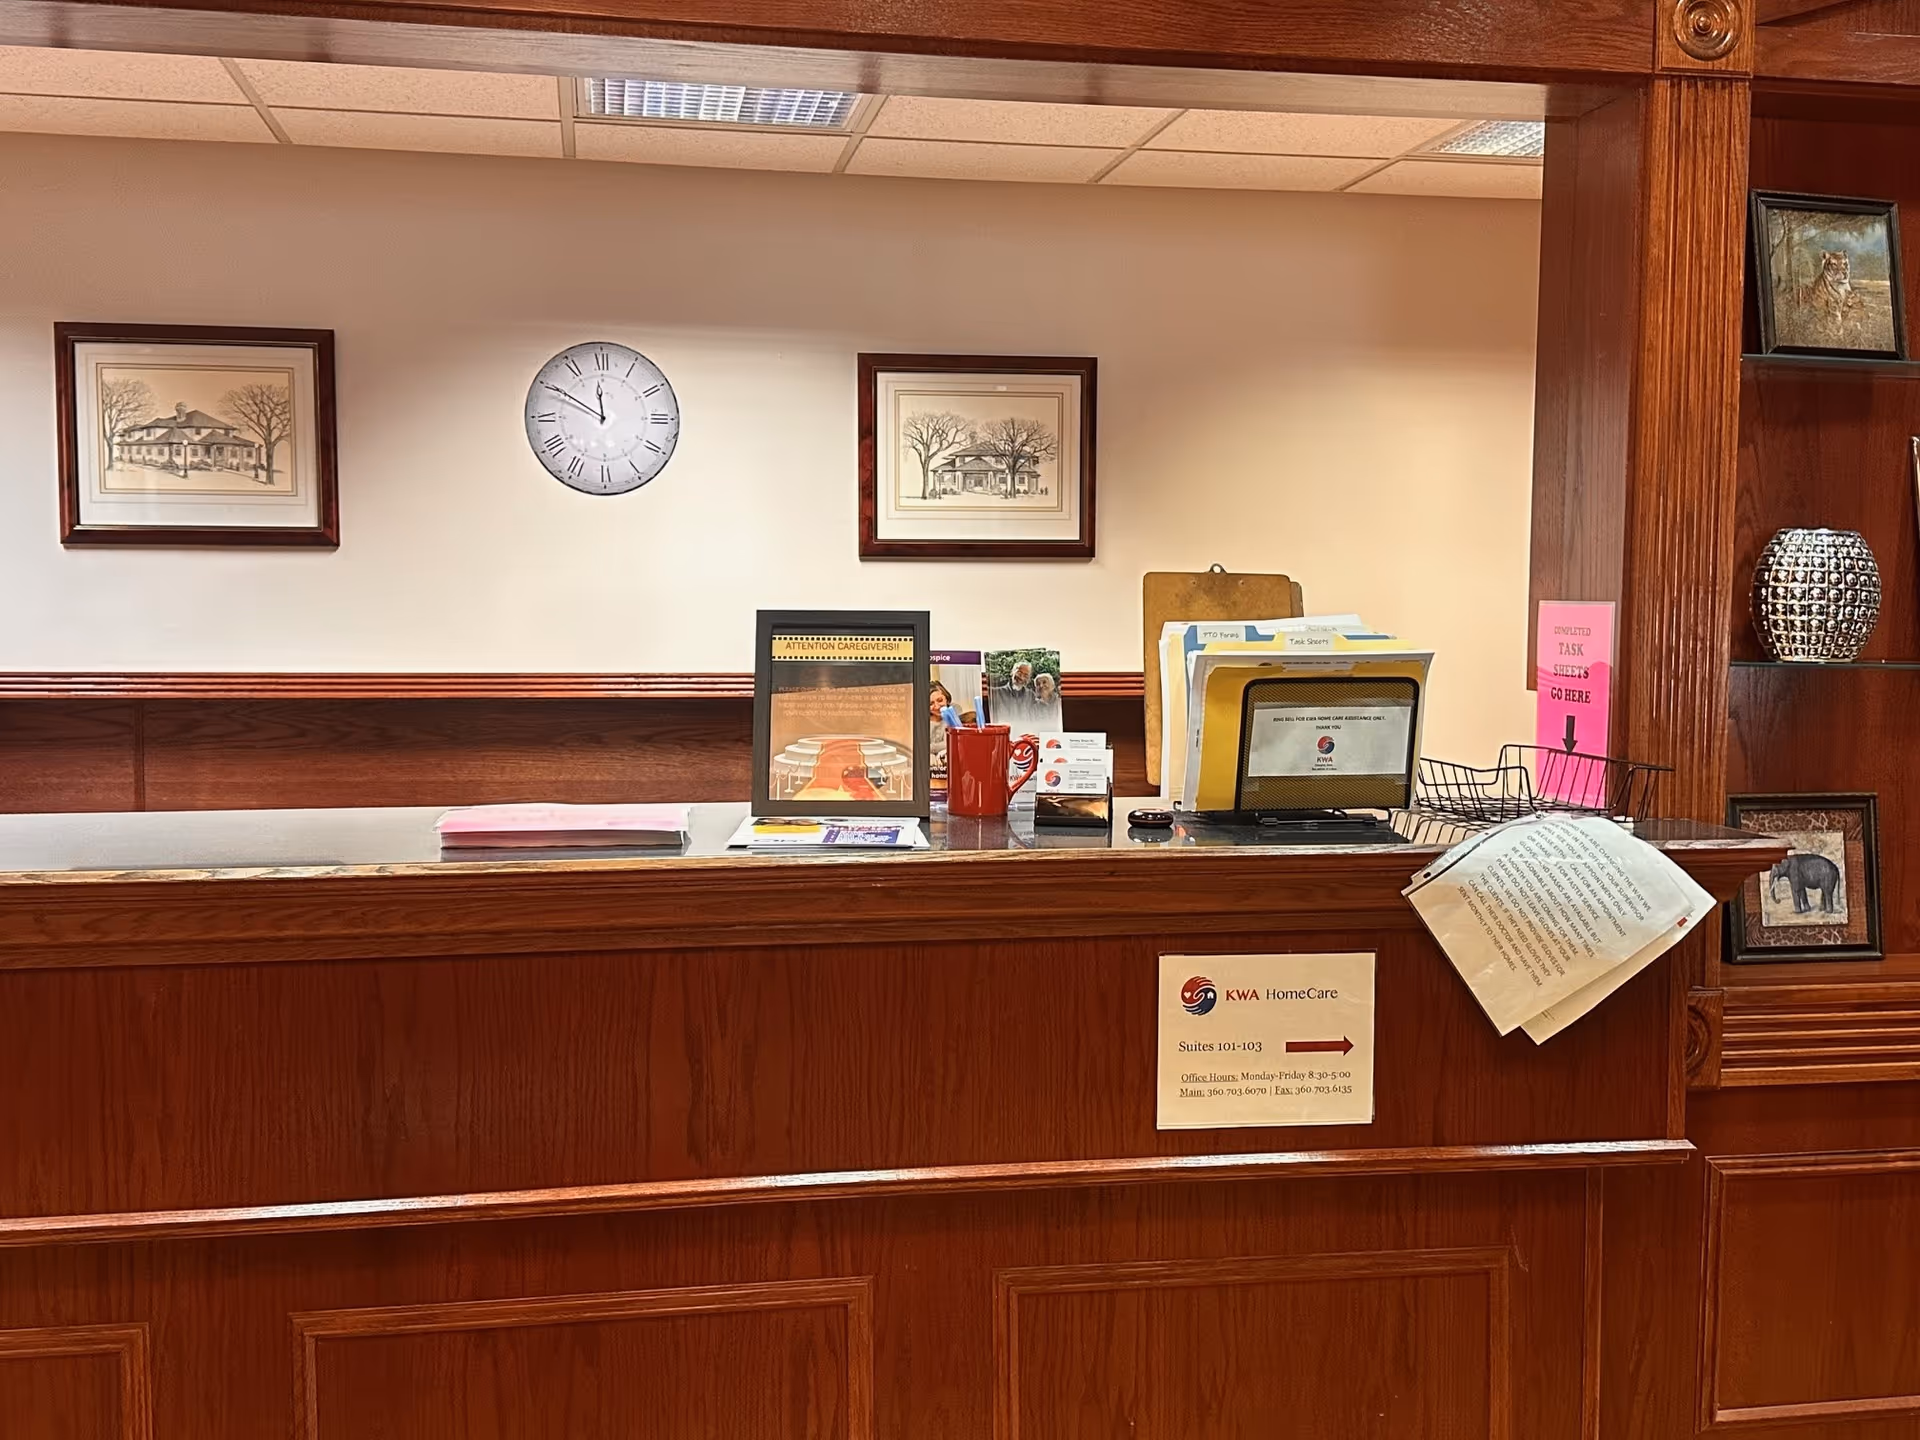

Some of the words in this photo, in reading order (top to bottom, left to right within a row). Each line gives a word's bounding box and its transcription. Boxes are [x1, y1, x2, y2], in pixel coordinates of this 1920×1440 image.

[785, 642, 835, 651] ATTENTION
[837, 642, 900, 651] CAREGIVERS!!
[1289, 638, 1306, 646] Task
[1307, 638, 1329, 646] Sheets
[1554, 626, 1591, 636] COMPLETED
[1559, 642, 1584, 656] TASK
[1553, 664, 1590, 679] SHEETS
[1551, 687, 1563, 700] GO
[1564, 689, 1591, 704] HERE
[1557, 865, 1568, 877] FOR
[1566, 877, 1583, 898] FASTER
[1578, 841, 1589, 852] THE
[1605, 872, 1620, 888] YOUR
[1617, 886, 1644, 921] SUPERVISOR
[1581, 862, 1615, 901] APPOINTMENT
[1588, 838, 1600, 849] ARE
[1598, 847, 1625, 877] CHANGING
[1623, 875, 1634, 888] THE
[1631, 886, 1644, 902] WAY
[1642, 900, 1652, 912] WE
[1496, 858, 1513, 878] PLEASE
[1510, 877, 1520, 888] DO
[1517, 887, 1529, 900] NOT
[1525, 899, 1540, 917] LEAVE
[1537, 916, 1555, 939] GLOVES
[1551, 937, 1560, 946] AT
[1557, 945, 1570, 961] YOUR
[1507, 857, 1526, 879] MONTH
[1524, 878, 1535, 892] YOU
[1532, 891, 1543, 903] ARE
[1540, 902, 1559, 927] COMING
[1557, 926, 1567, 938] FOR
[1548, 872, 1564, 892] MASKS
[1562, 891, 1573, 904] ARE
[1570, 903, 1592, 932] AVAILABLE
[1589, 931, 1601, 944] BUT
[1569, 863, 1581, 877] CALL
[1579, 876, 1591, 889] FOR
[1588, 887, 1598, 898] AN
[1595, 897, 1626, 937] APPOINTMENT
[1456, 885, 1470, 900] SENT
[1466, 899, 1487, 927] MONTHLY
[1484, 926, 1493, 936] TO
[1489, 934, 1503, 951] THEIR
[1467, 878, 1479, 892] CAN
[1475, 890, 1487, 905] CALL
[1484, 904, 1498, 921] THEIR
[1495, 919, 1513, 943] DOCTOR
[1510, 942, 1522, 956] AND
[1518, 954, 1532, 971] HAVE
[1528, 969, 1542, 987] THEM
[1479, 873, 1489, 886] THE
[1506, 913, 1519, 928] THEY
[1514, 927, 1528, 943] NEED
[1524, 941, 1542, 964] GLOVES
[1538, 962, 1551, 977] THEY
[1504, 888, 1513, 899] WE
[1510, 898, 1520, 908] DO
[1516, 907, 1528, 920] NOT
[1525, 919, 1544, 944] PROVIDE
[1540, 942, 1558, 965] GLOVES
[1554, 963, 1565, 976] FOR
[1545, 888, 1561, 907] ABOUT
[1558, 907, 1571, 922] HOW
[1568, 922, 1583, 940] MANY
[1580, 939, 1595, 958] TIMES
[1226, 989, 1260, 1001] KWA
[1266, 987, 1338, 1000] HomeCare
[1178, 1041, 1214, 1052] Suites
[1217, 1041, 1263, 1052] 101-103
[1179, 1087, 1205, 1097] Main:
[1207, 1087, 1267, 1097] 360.703.6070
[1274, 1086, 1293, 1096] Fax:
[1295, 1085, 1352, 1095] 360.703.6135
[1181, 1073, 1207, 1083] Office
[1209, 1072, 1238, 1082] Hours:
[1241, 1071, 1306, 1082] Monday-Friday
